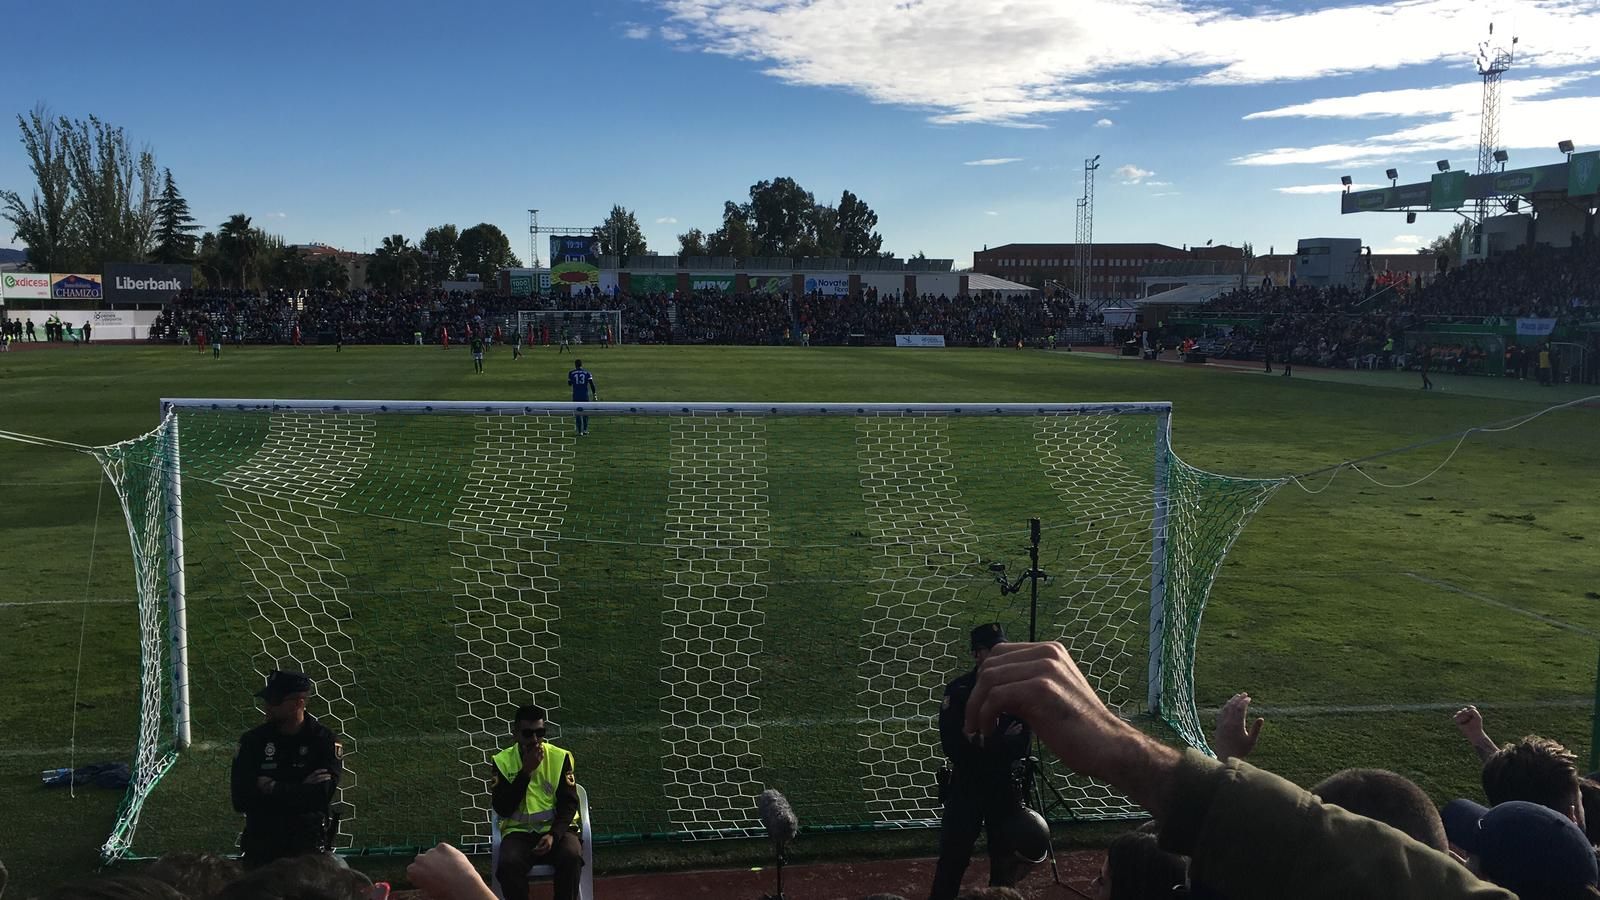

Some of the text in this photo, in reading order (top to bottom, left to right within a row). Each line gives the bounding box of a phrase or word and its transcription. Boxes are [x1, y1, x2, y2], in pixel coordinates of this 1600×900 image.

[115, 276, 182, 291] Liberbank
[818, 279, 849, 288] Novatel
[55, 288, 99, 297] CHAMIZO
[574, 373, 586, 385] 13
